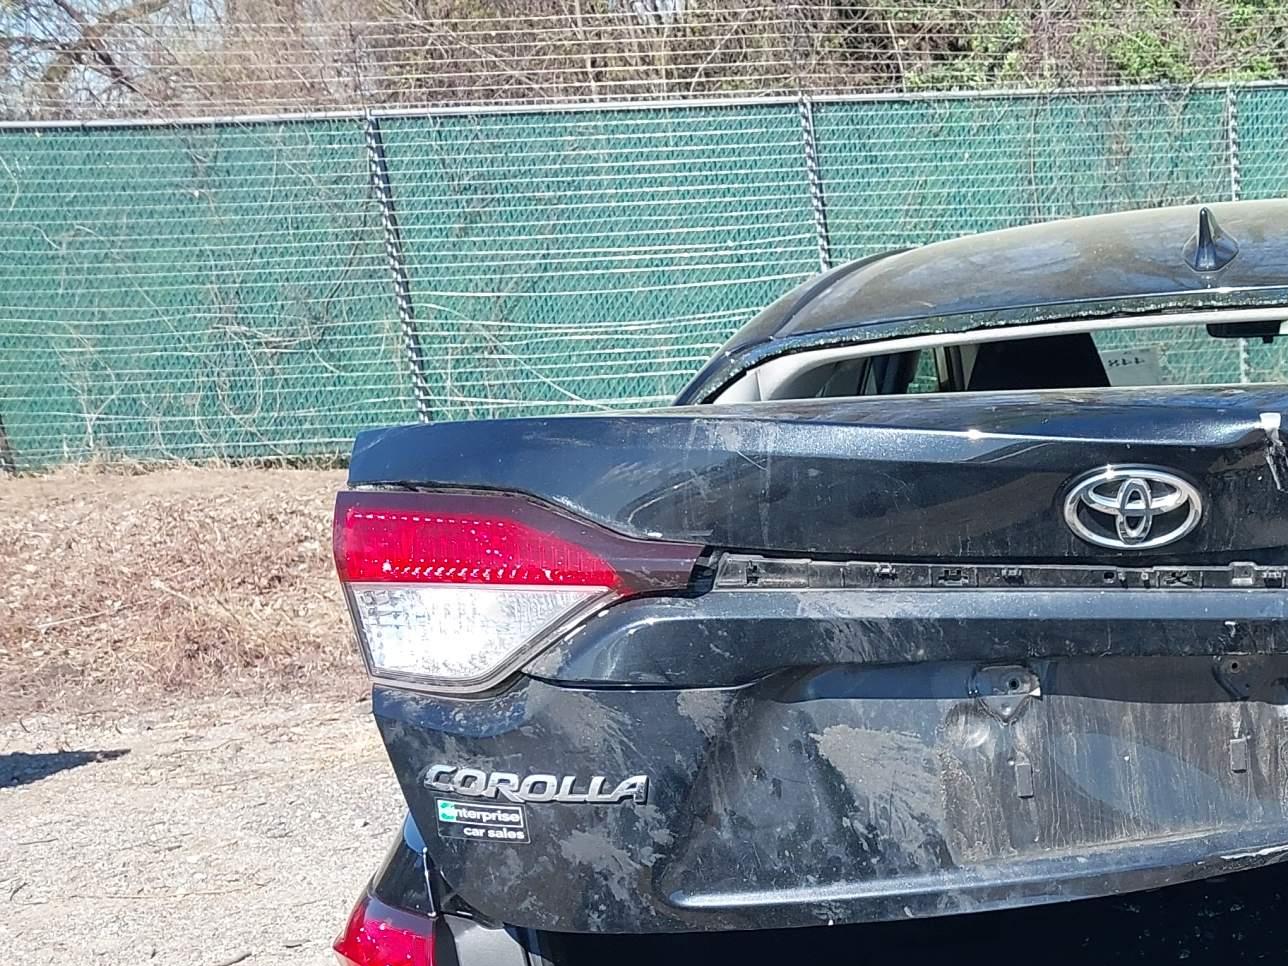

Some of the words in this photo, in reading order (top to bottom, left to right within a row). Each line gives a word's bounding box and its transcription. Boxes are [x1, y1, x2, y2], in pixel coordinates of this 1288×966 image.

[424, 764, 649, 805] COROLLA
[440, 802, 520, 823] enterprise
[463, 827, 485, 837] car
[487, 827, 525, 840] sales
